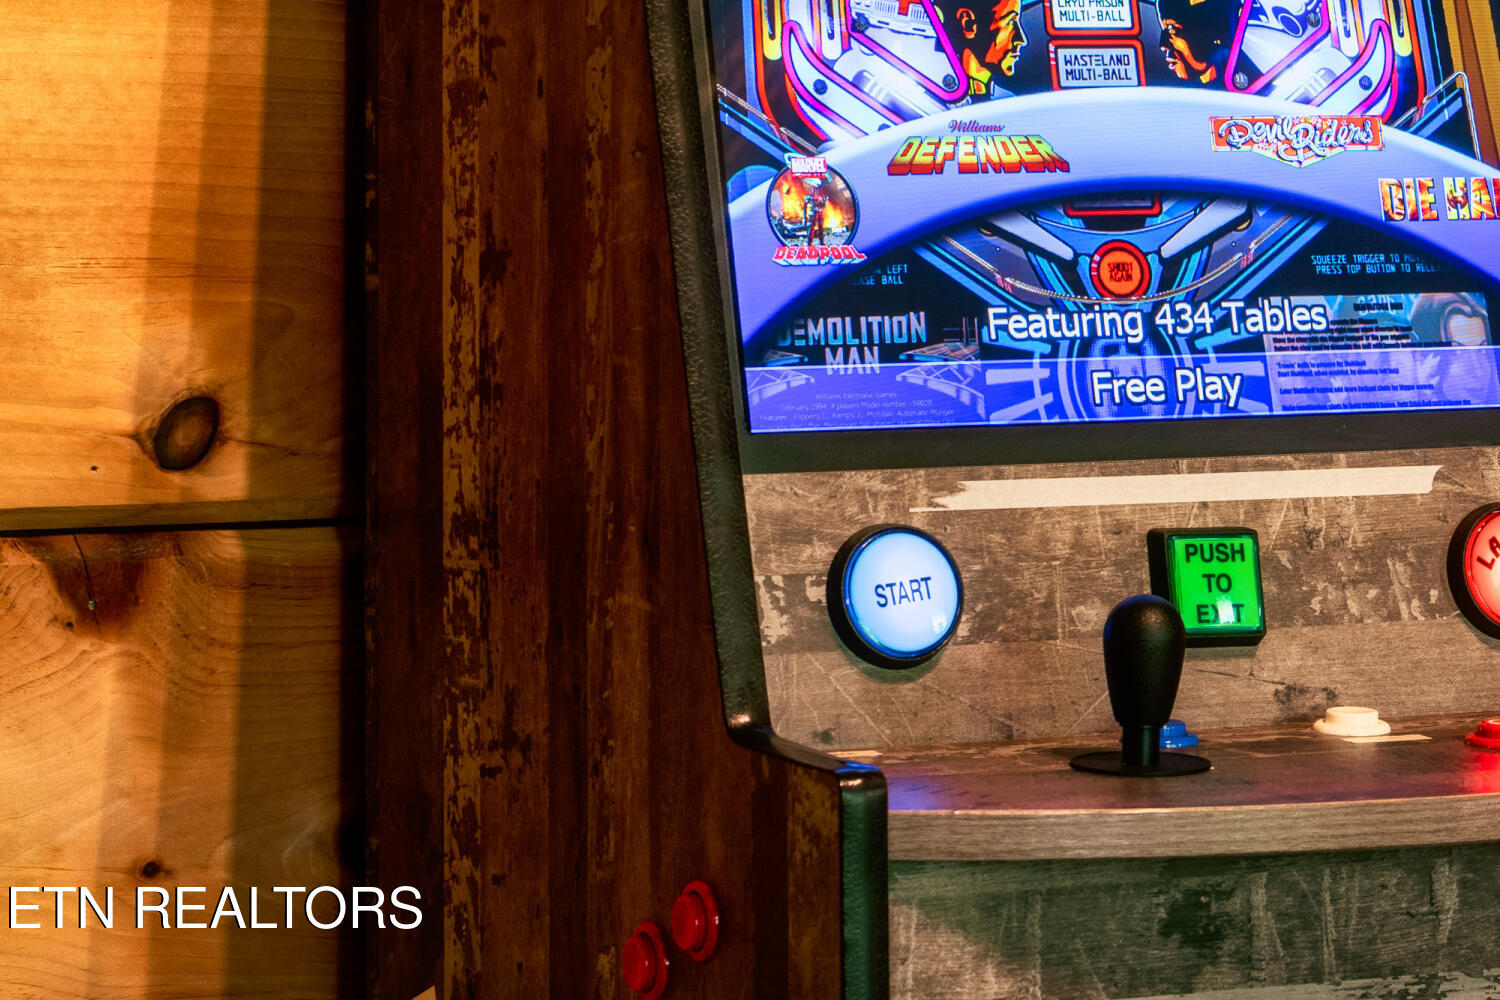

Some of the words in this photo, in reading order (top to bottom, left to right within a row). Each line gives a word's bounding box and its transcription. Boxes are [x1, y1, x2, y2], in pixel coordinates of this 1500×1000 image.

[1059, 10, 1125, 22] MULTI-BALL
[1063, 54, 1131, 67] WASTELAND
[1065, 68, 1132, 81] MULTI-BALL
[948, 119, 1006, 133] Williams
[1218, 115, 1293, 149] Devil
[1280, 119, 1374, 161] Riders
[887, 135, 1070, 175] DEFENDER
[791, 157, 827, 173] MARVEL
[1378, 177, 1439, 221] DIE
[772, 245, 868, 266] DEADPOOL
[1311, 255, 1347, 265] SQUEEZE
[1353, 254, 1385, 264] TRIGGER
[1390, 253, 1400, 263] TO
[887, 264, 908, 274] LEFT
[1107, 262, 1133, 272] SHOOT
[1316, 265, 1343, 274] PRESS
[1347, 264, 1361, 274] TOP
[1366, 263, 1396, 274] BUTTON
[1401, 263, 1411, 273] TO
[881, 274, 904, 285] BALL
[1109, 271, 1133, 282] AGAIN
[986, 306, 1144, 343] Featuring
[1154, 302, 1214, 335] 434
[1221, 299, 1328, 334] Tables
[825, 346, 880, 375] MAN
[1091, 369, 1166, 405] Free
[1175, 367, 1242, 408] Play
[1184, 542, 1246, 563] PUSH
[874, 576, 932, 608] START
[1201, 573, 1232, 593] TO
[1196, 603, 1245, 624] EXT
